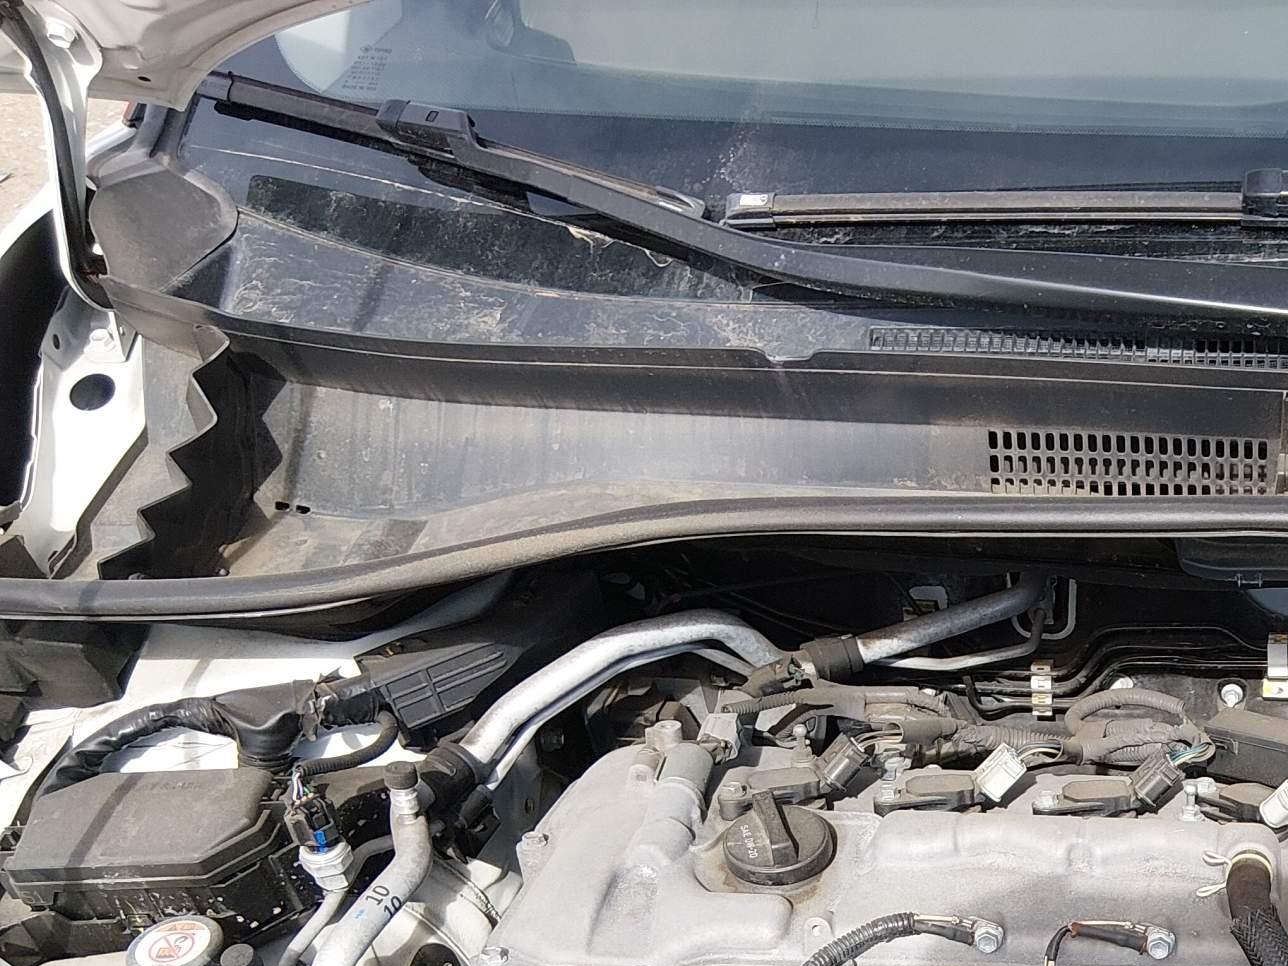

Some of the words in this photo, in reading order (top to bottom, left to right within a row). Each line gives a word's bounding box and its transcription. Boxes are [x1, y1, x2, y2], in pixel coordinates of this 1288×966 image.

[740, 825, 752, 838] SAE
[366, 885, 390, 906] 10
[384, 895, 402, 918] 10
